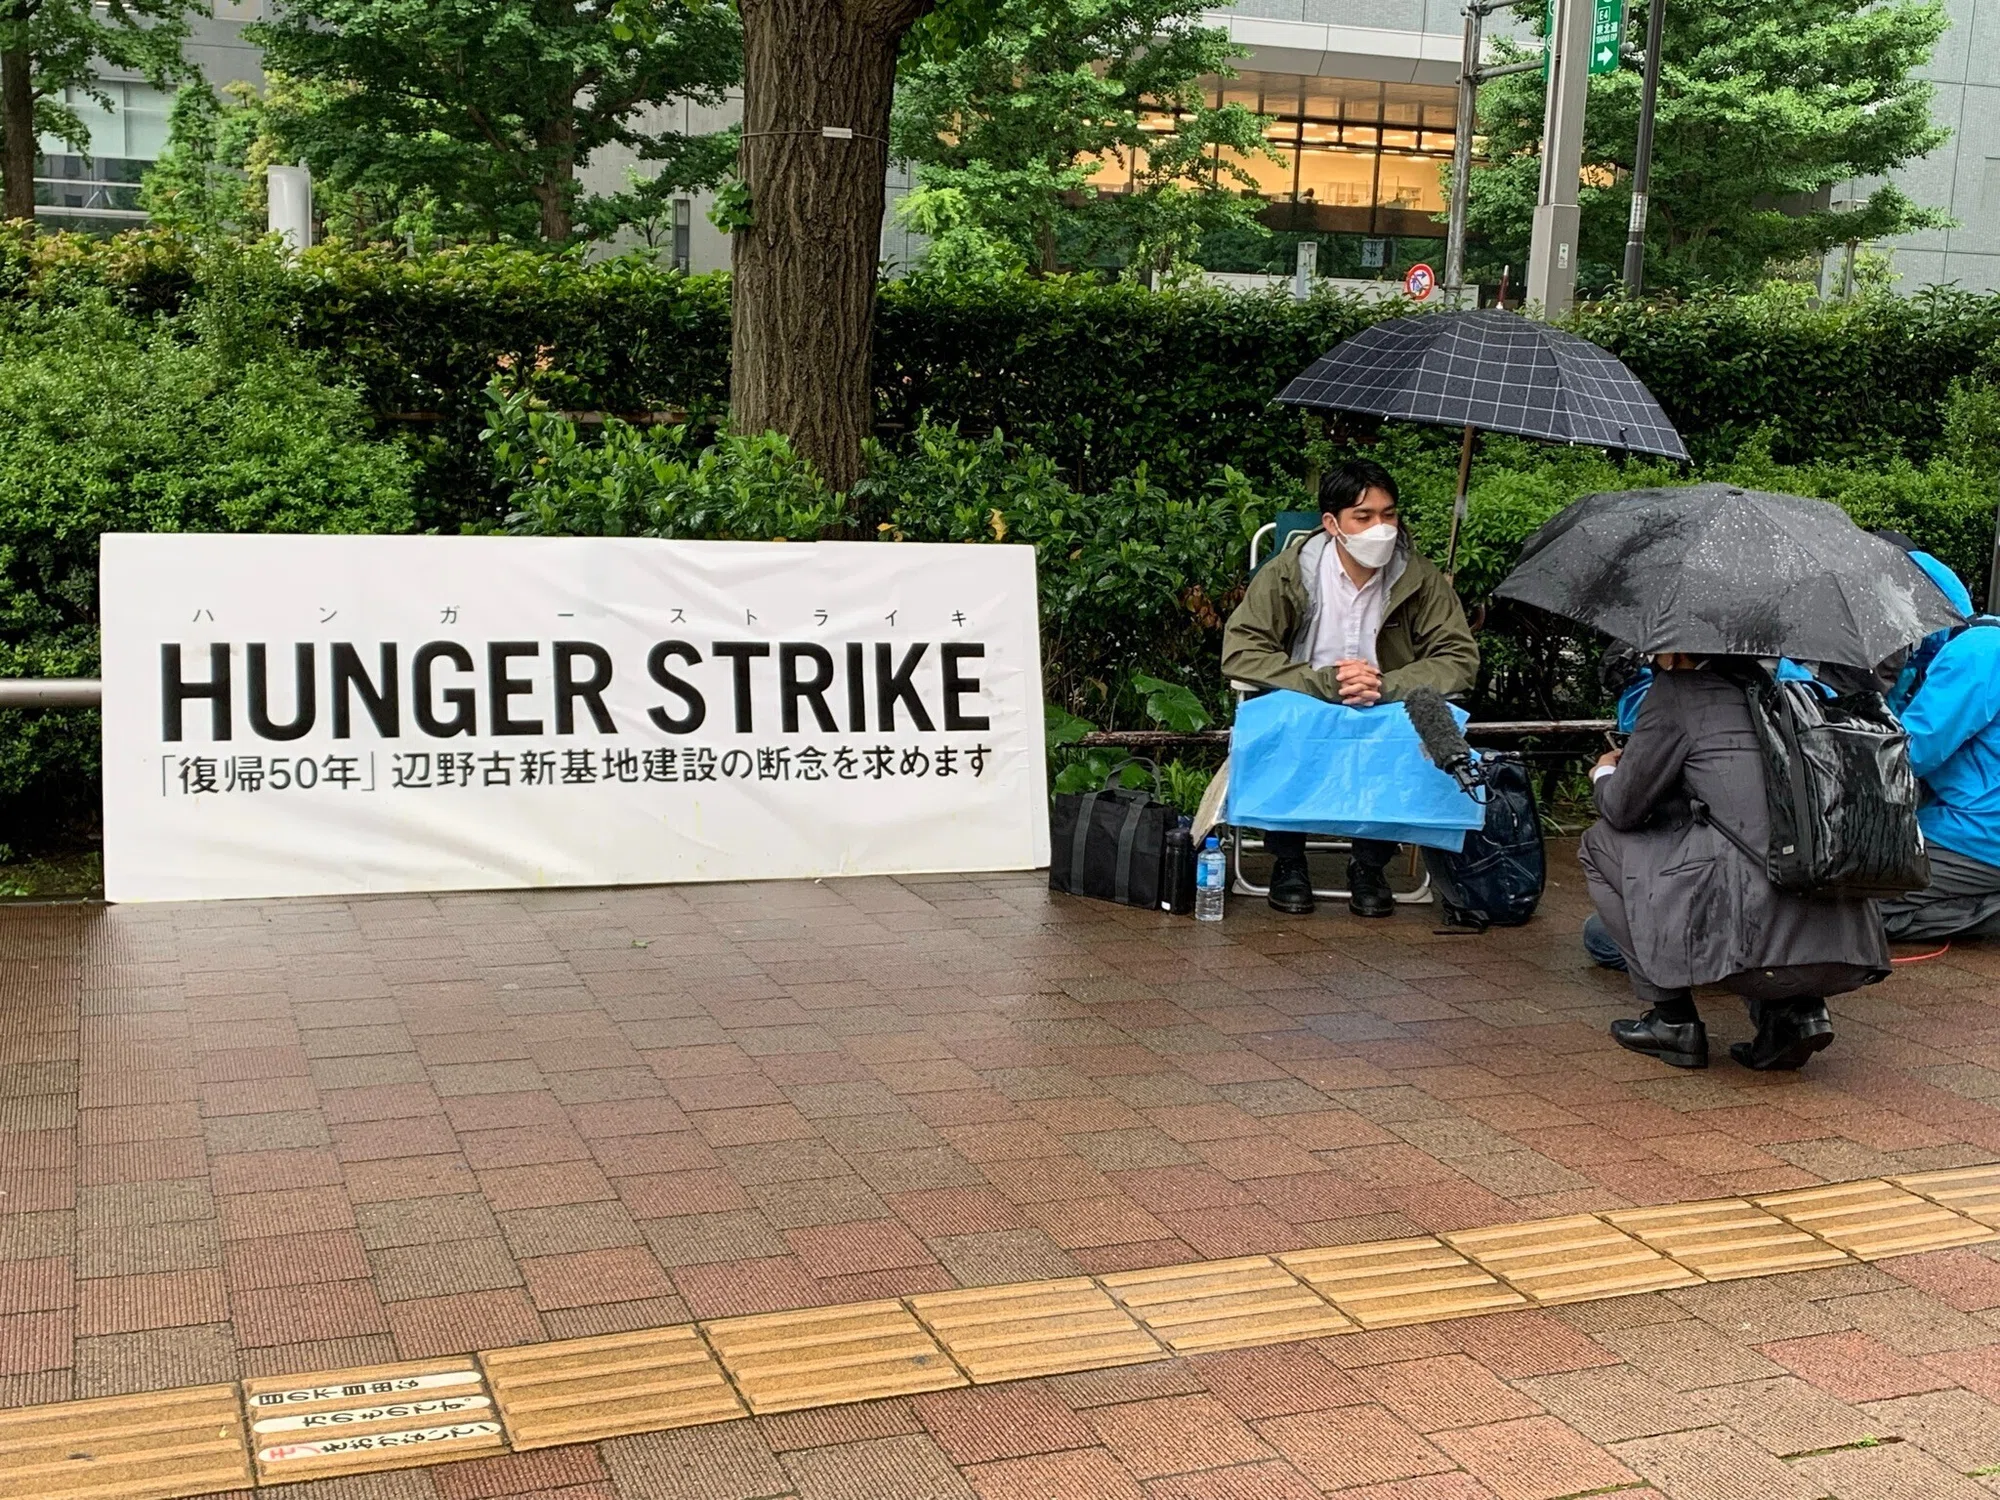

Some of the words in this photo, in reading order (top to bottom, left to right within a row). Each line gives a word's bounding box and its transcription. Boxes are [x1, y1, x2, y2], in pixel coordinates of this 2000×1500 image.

[1599, 9, 1609, 21] E4
[161, 640, 619, 742] HUNGER
[647, 640, 990, 735] STRIKE
[258, 1380, 419, 1405] 目の不自由な
[302, 1397, 472, 1427] 方のものです。
